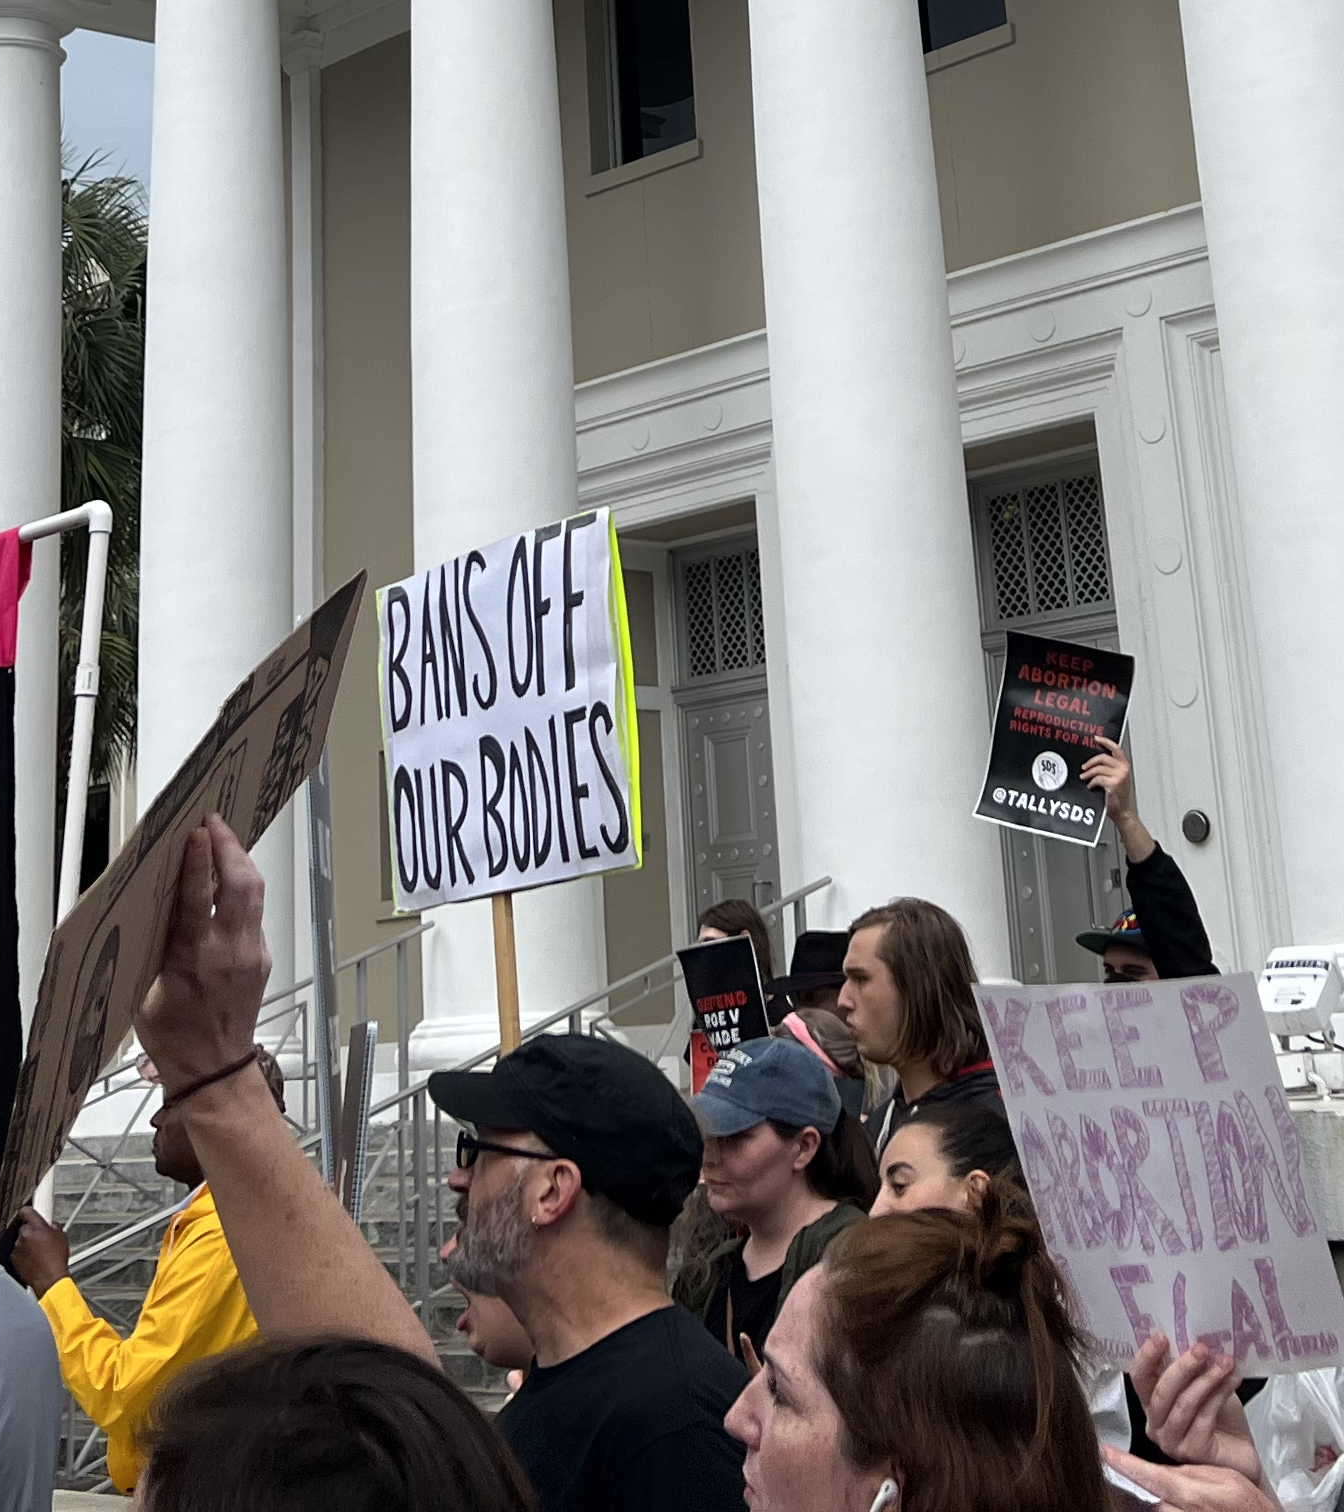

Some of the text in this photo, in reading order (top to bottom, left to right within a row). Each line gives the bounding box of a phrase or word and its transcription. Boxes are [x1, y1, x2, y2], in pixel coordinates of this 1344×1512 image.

[387, 510, 597, 733] BANS OFF
[1046, 650, 1094, 672] KEEP
[1018, 663, 1117, 700] ABORTION
[1034, 688, 1091, 716] LEGAL
[1010, 719, 1099, 749] RIGHTS FOR AL
[1013, 706, 1105, 736] REPRODUCTIVE
[1041, 759, 1057, 776] SDS
[393, 700, 629, 894] OUR BODIES
[992, 786, 1096, 826] @TALLYSDS
[703, 1007, 739, 1029] ROE V
[981, 983, 1240, 1098] KEEP
[1019, 1085, 1318, 1257] ABORTION
